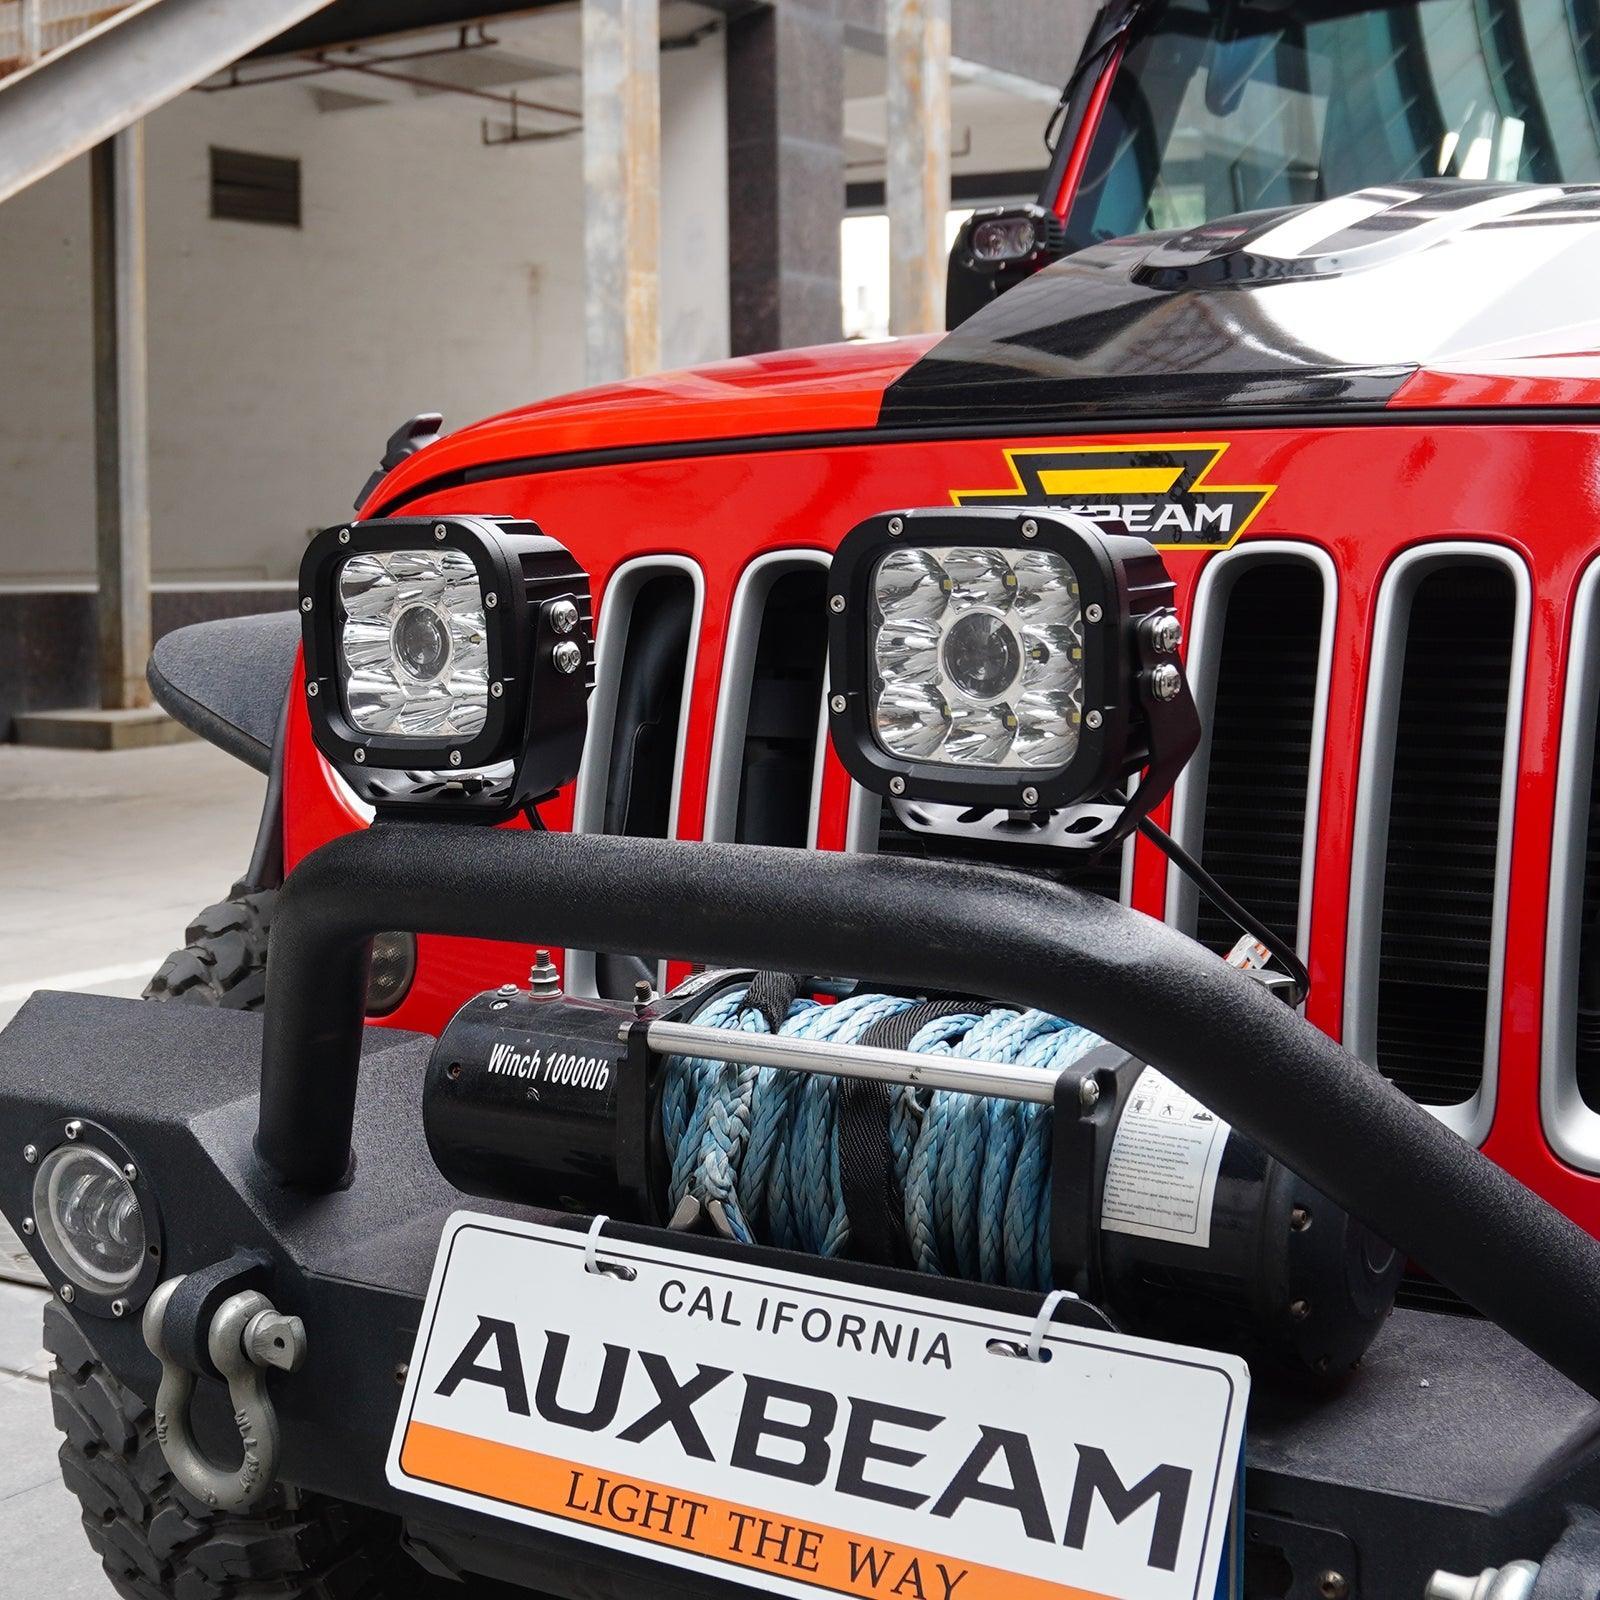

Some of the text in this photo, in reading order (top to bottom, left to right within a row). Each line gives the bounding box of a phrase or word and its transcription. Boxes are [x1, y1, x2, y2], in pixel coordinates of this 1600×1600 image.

[487, 1043, 610, 1091] Winch 10000lb
[659, 1279, 952, 1370] CALIFORNIA
[434, 1314, 1193, 1573] AUXBEAM
[564, 1470, 969, 1600] LIGHT THE WAY
